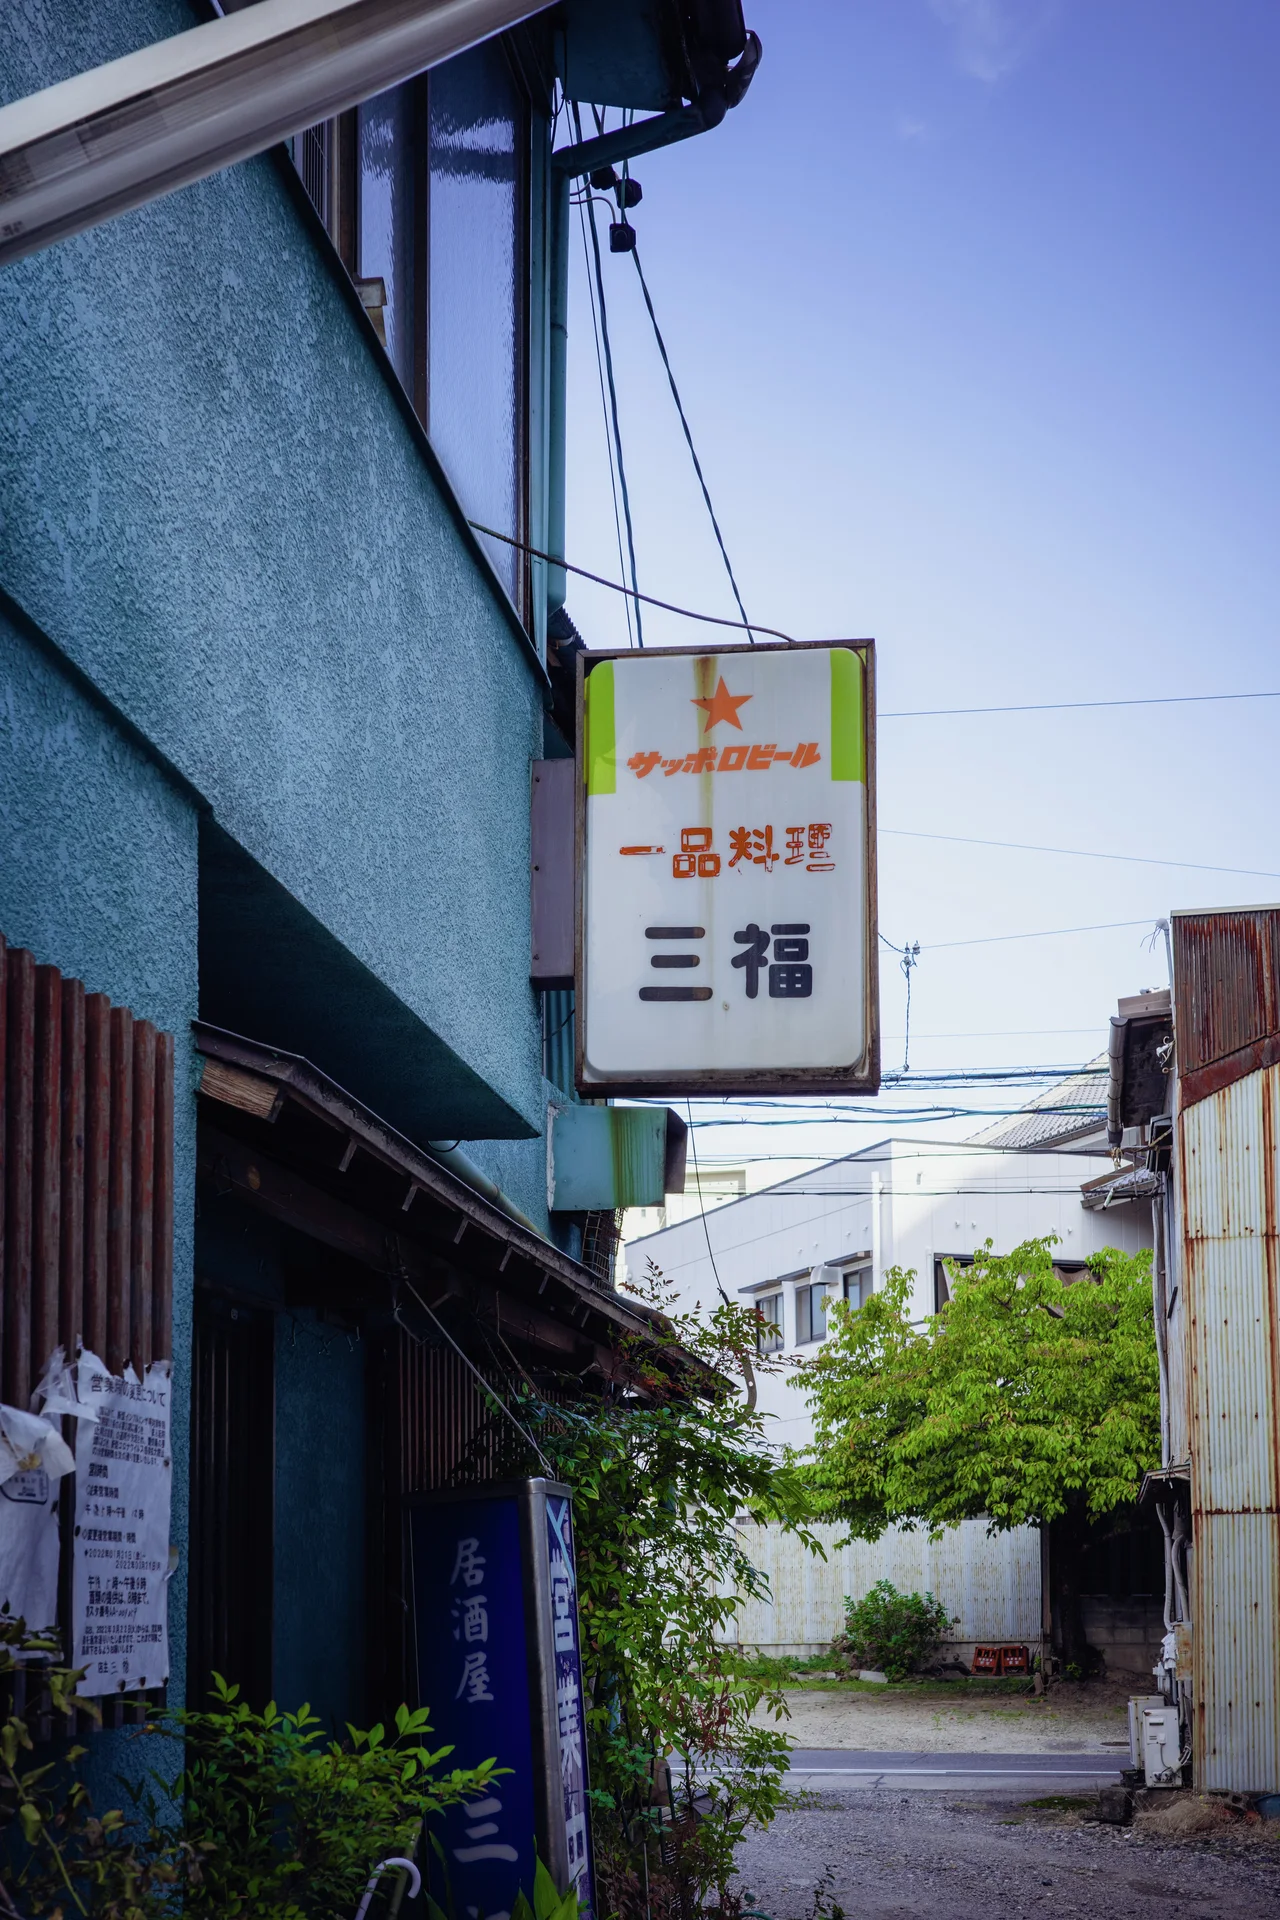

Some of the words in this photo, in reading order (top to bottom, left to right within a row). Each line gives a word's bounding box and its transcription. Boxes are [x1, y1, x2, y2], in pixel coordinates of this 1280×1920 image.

[626, 742, 822, 780] サッポロビール
[618, 822, 837, 879] 一品料理
[638, 922, 814, 1002] 三福
[449, 1536, 495, 1704] 居酒屋
[452, 1796, 519, 1920] 三
